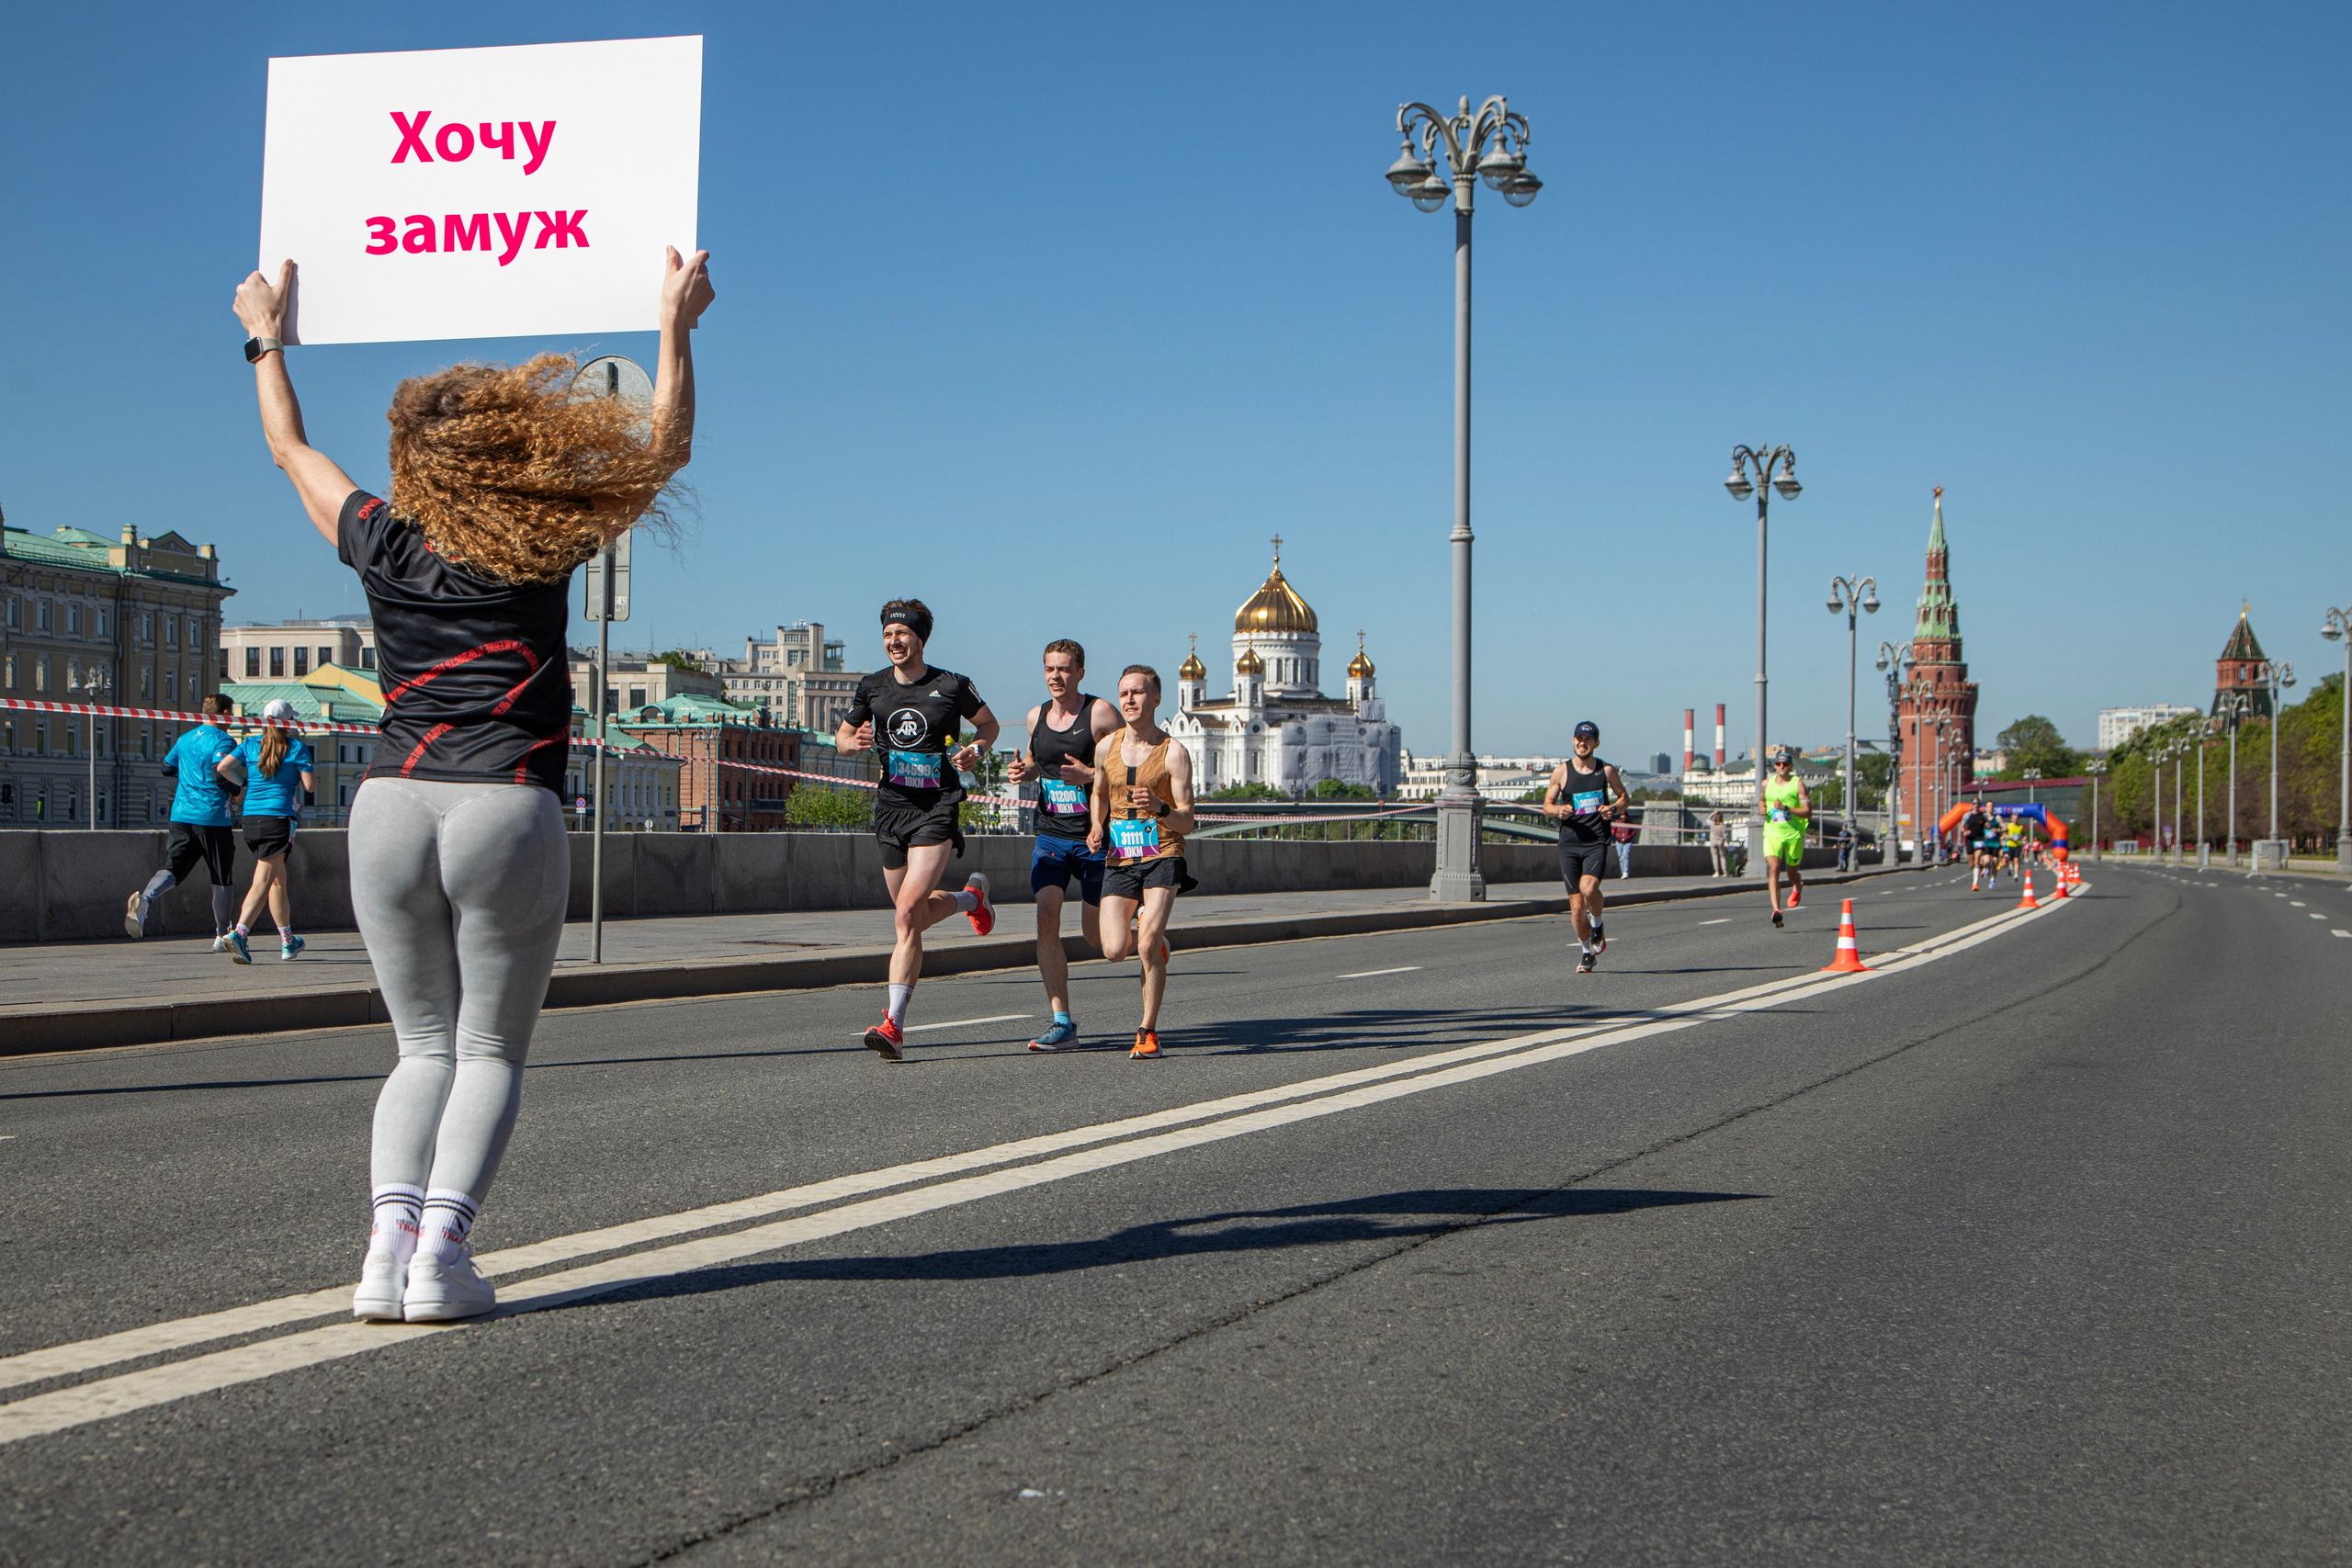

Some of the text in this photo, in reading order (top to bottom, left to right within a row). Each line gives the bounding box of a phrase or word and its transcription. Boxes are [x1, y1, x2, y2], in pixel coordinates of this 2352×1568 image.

[389, 110, 557, 175] Хочу
[365, 209, 590, 267] замуж
[898, 762, 932, 777] 34599
[904, 776, 924, 788] 10KM
[1049, 789, 1077, 802] 31200
[1057, 803, 1075, 814] 10KM
[1121, 830, 1145, 846] 31111
[1124, 845, 1144, 858] 10KM
